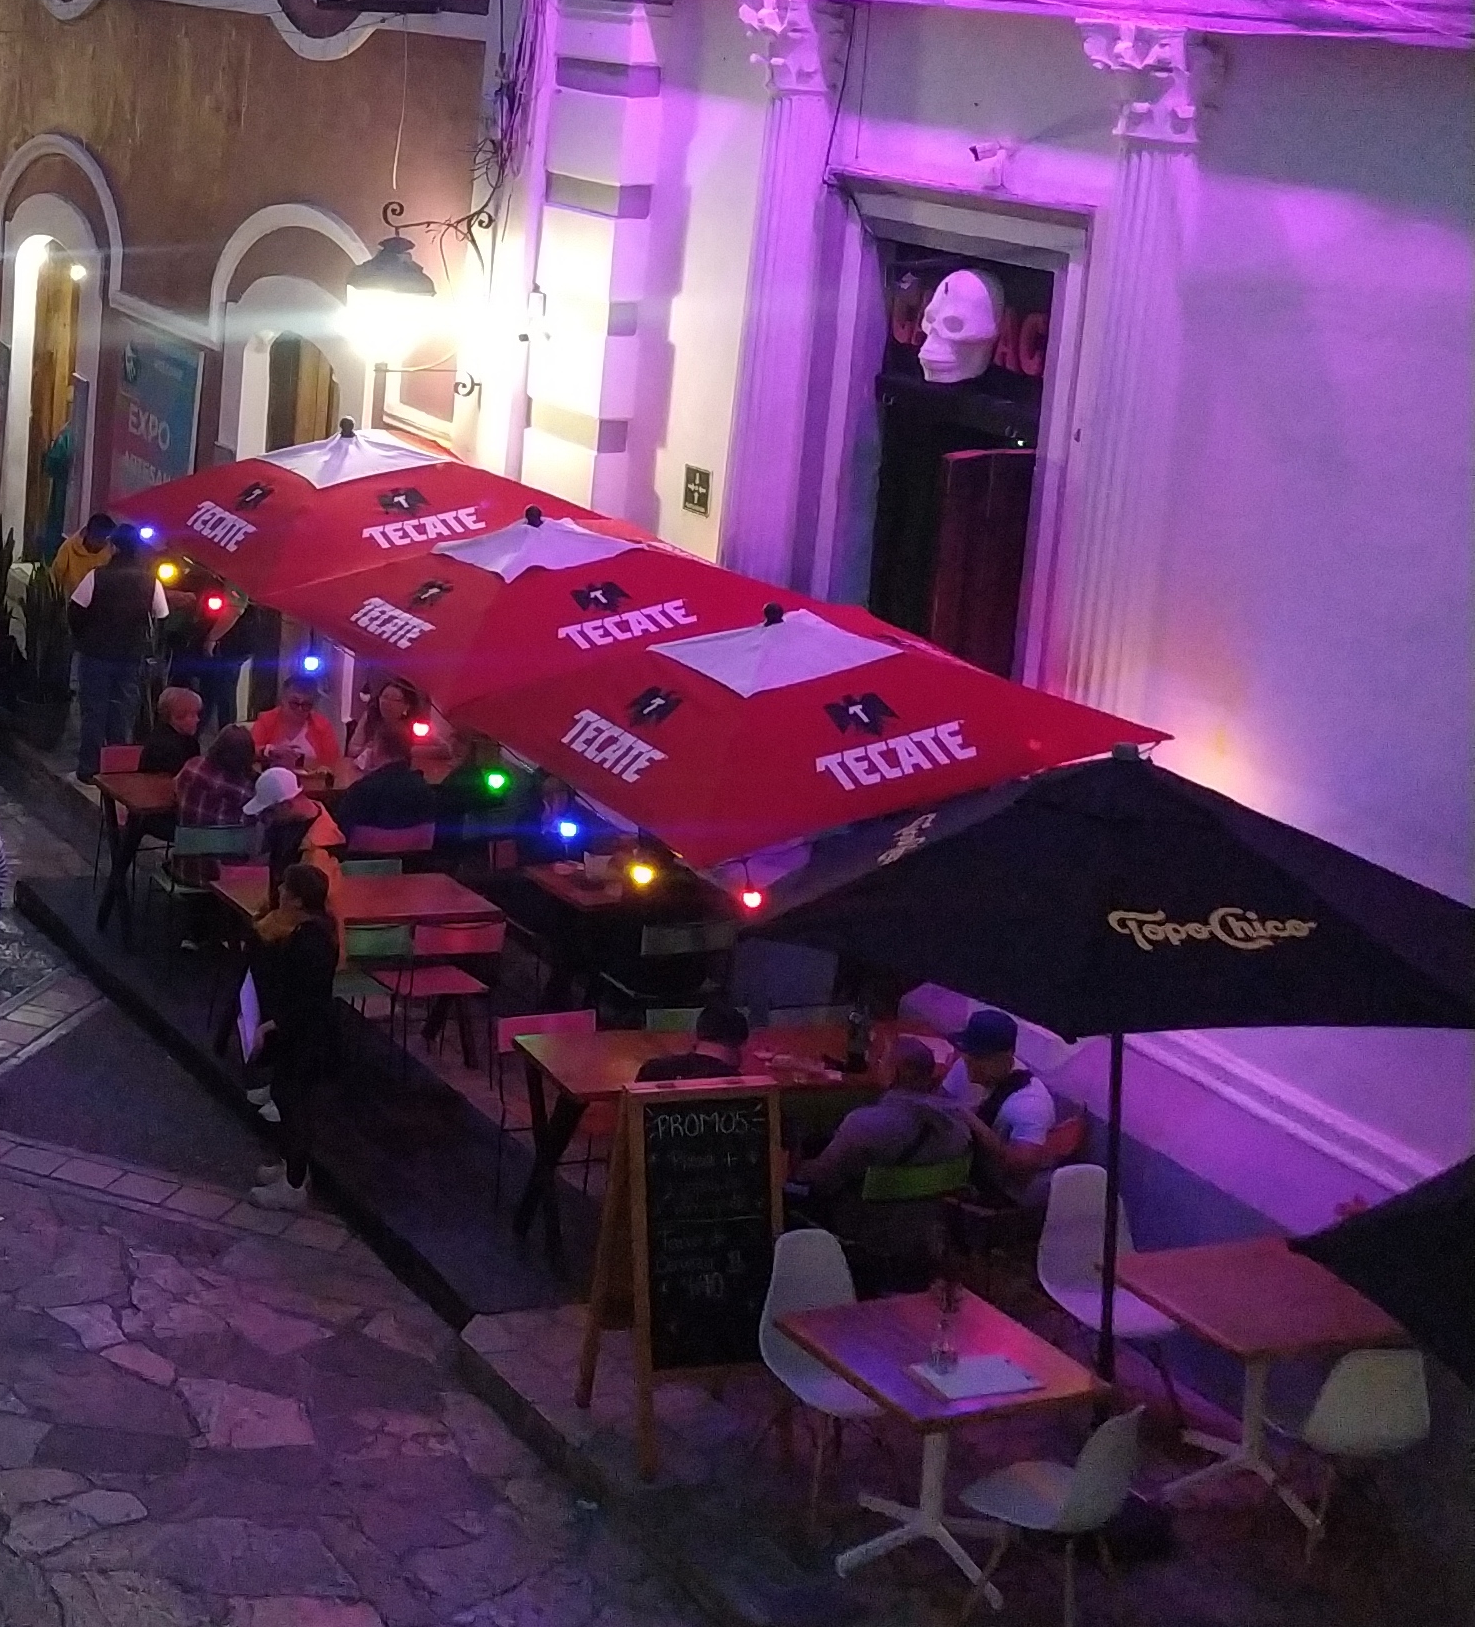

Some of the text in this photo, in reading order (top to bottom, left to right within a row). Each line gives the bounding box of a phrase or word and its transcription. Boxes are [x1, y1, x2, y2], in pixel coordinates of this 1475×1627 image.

[128, 402, 171, 451] EXPO
[186, 500, 258, 552] TECATE
[362, 505, 488, 550] TECATE
[349, 596, 437, 650] TECATE
[557, 598, 698, 650] TECATE
[560, 709, 668, 783] TECATE
[815, 719, 977, 792] TECATE
[655, 1110, 749, 1139] PROMOS
